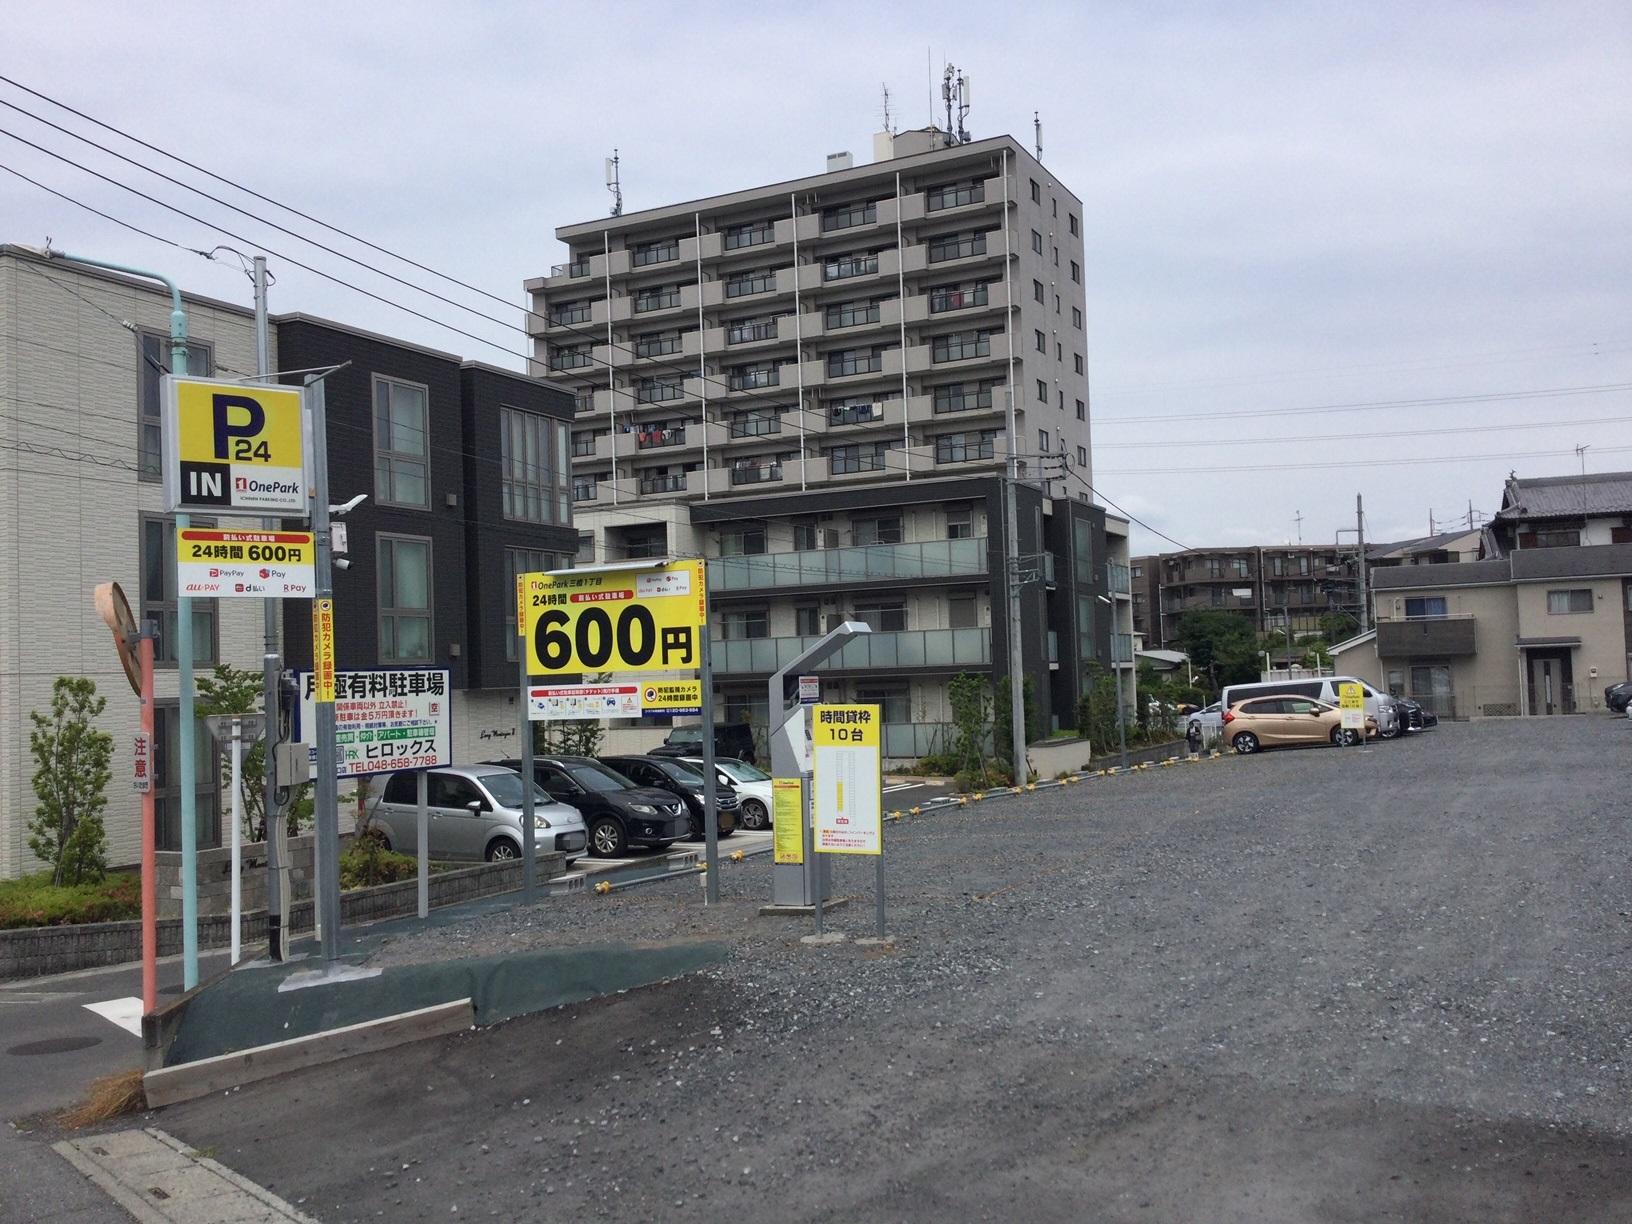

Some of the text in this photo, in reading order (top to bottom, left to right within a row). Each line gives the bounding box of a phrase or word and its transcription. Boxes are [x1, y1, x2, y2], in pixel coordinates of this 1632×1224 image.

[212, 393, 266, 460] P
[235, 438, 272, 463] 24
[189, 471, 222, 497] IN
[249, 480, 300, 494] OnePark
[192, 544, 302, 562] 24時間 600円
[219, 569, 245, 577] PayPay
[271, 570, 286, 579] Pay
[204, 583, 220, 591] PAY
[290, 584, 307, 593] Pay
[538, 580, 569, 590] OnePark
[532, 594, 567, 606] 24時間
[535, 603, 693, 670] 600円
[820, 710, 872, 725] 時間貸枠
[829, 728, 864, 742] 10台
[366, 740, 437, 759] ヒロックス
[134, 737, 147, 778] 注意
